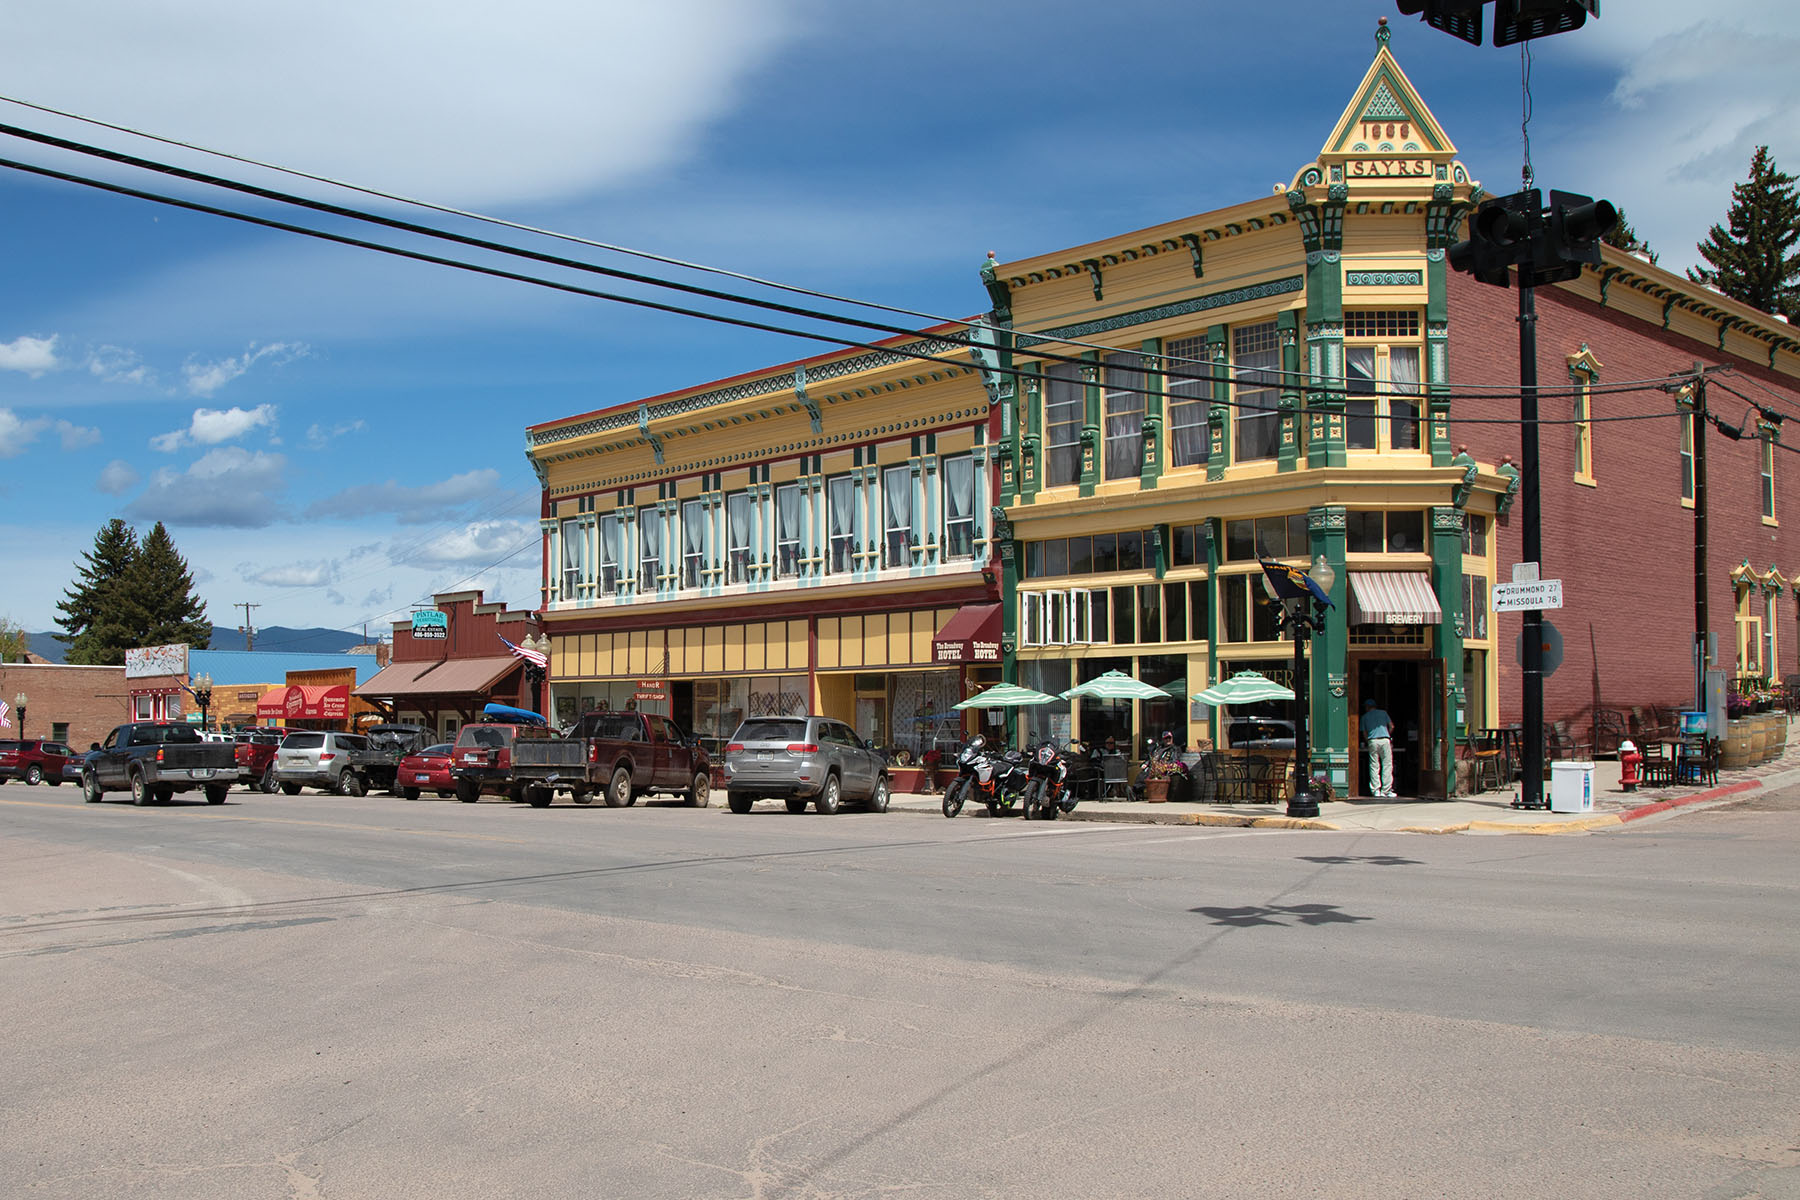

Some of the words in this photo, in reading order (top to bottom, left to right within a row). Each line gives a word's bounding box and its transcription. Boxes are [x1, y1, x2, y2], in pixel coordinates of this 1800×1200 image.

[1354, 160, 1424, 175] SAYRS
[1506, 586, 1544, 595] DRUMMOND
[1507, 597, 1543, 605] MISSOULA
[1386, 615, 1424, 624] BREWERY
[944, 642, 963, 650] Broadway
[981, 641, 999, 650] Broadway
[938, 650, 961, 660] HOTEL
[975, 649, 997, 659] HOTEL
